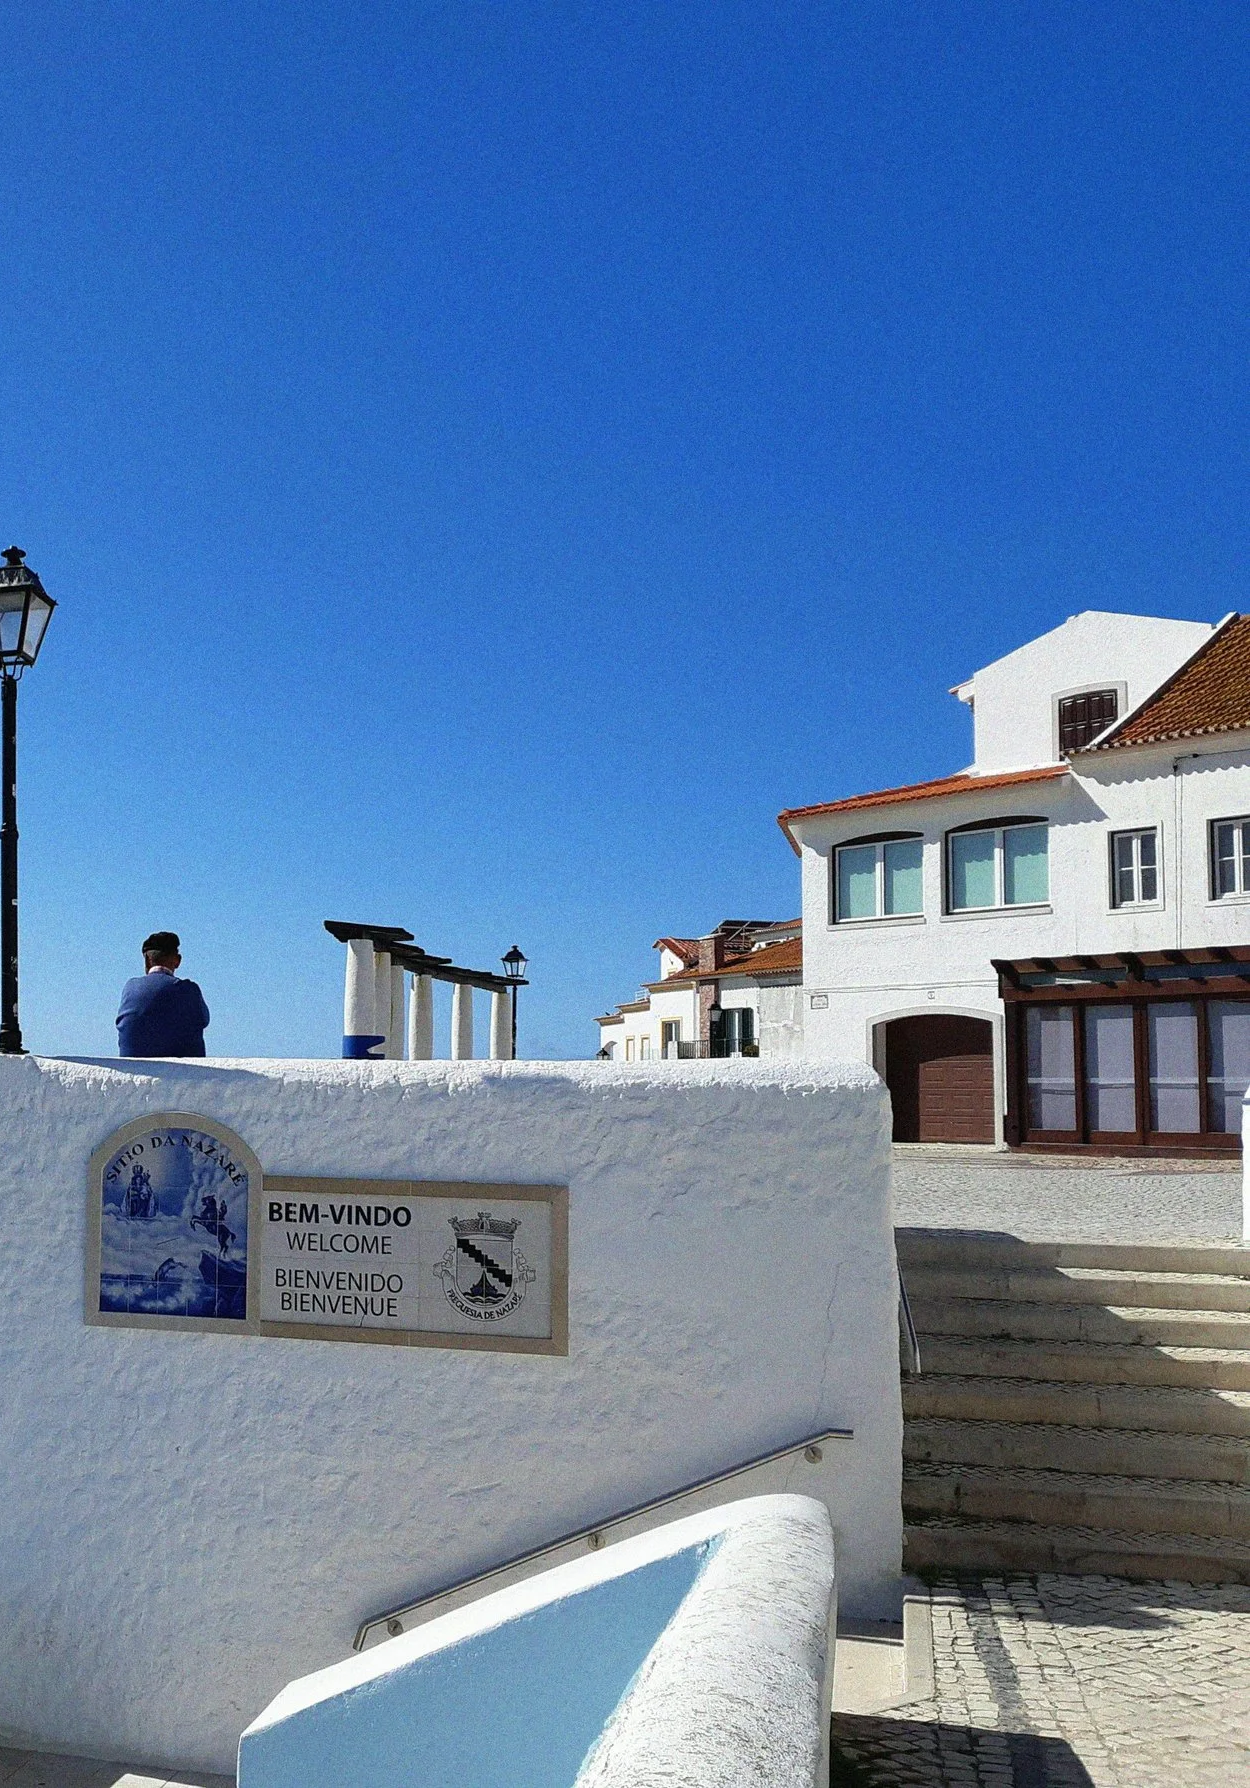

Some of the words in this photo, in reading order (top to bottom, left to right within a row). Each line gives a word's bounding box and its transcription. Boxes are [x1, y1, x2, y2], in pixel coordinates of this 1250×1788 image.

[151, 1135, 175, 1149] DA
[181, 1135, 246, 1187] NAZARÉ
[268, 1202, 412, 1227] BEM-VINDO
[286, 1232, 392, 1255] WELCOME
[275, 1268, 403, 1293] BIENVENIDO
[281, 1292, 398, 1317] BIENVENUE
[447, 1289, 483, 1319] FREGUESIA
[484, 1311, 496, 1320] DE
